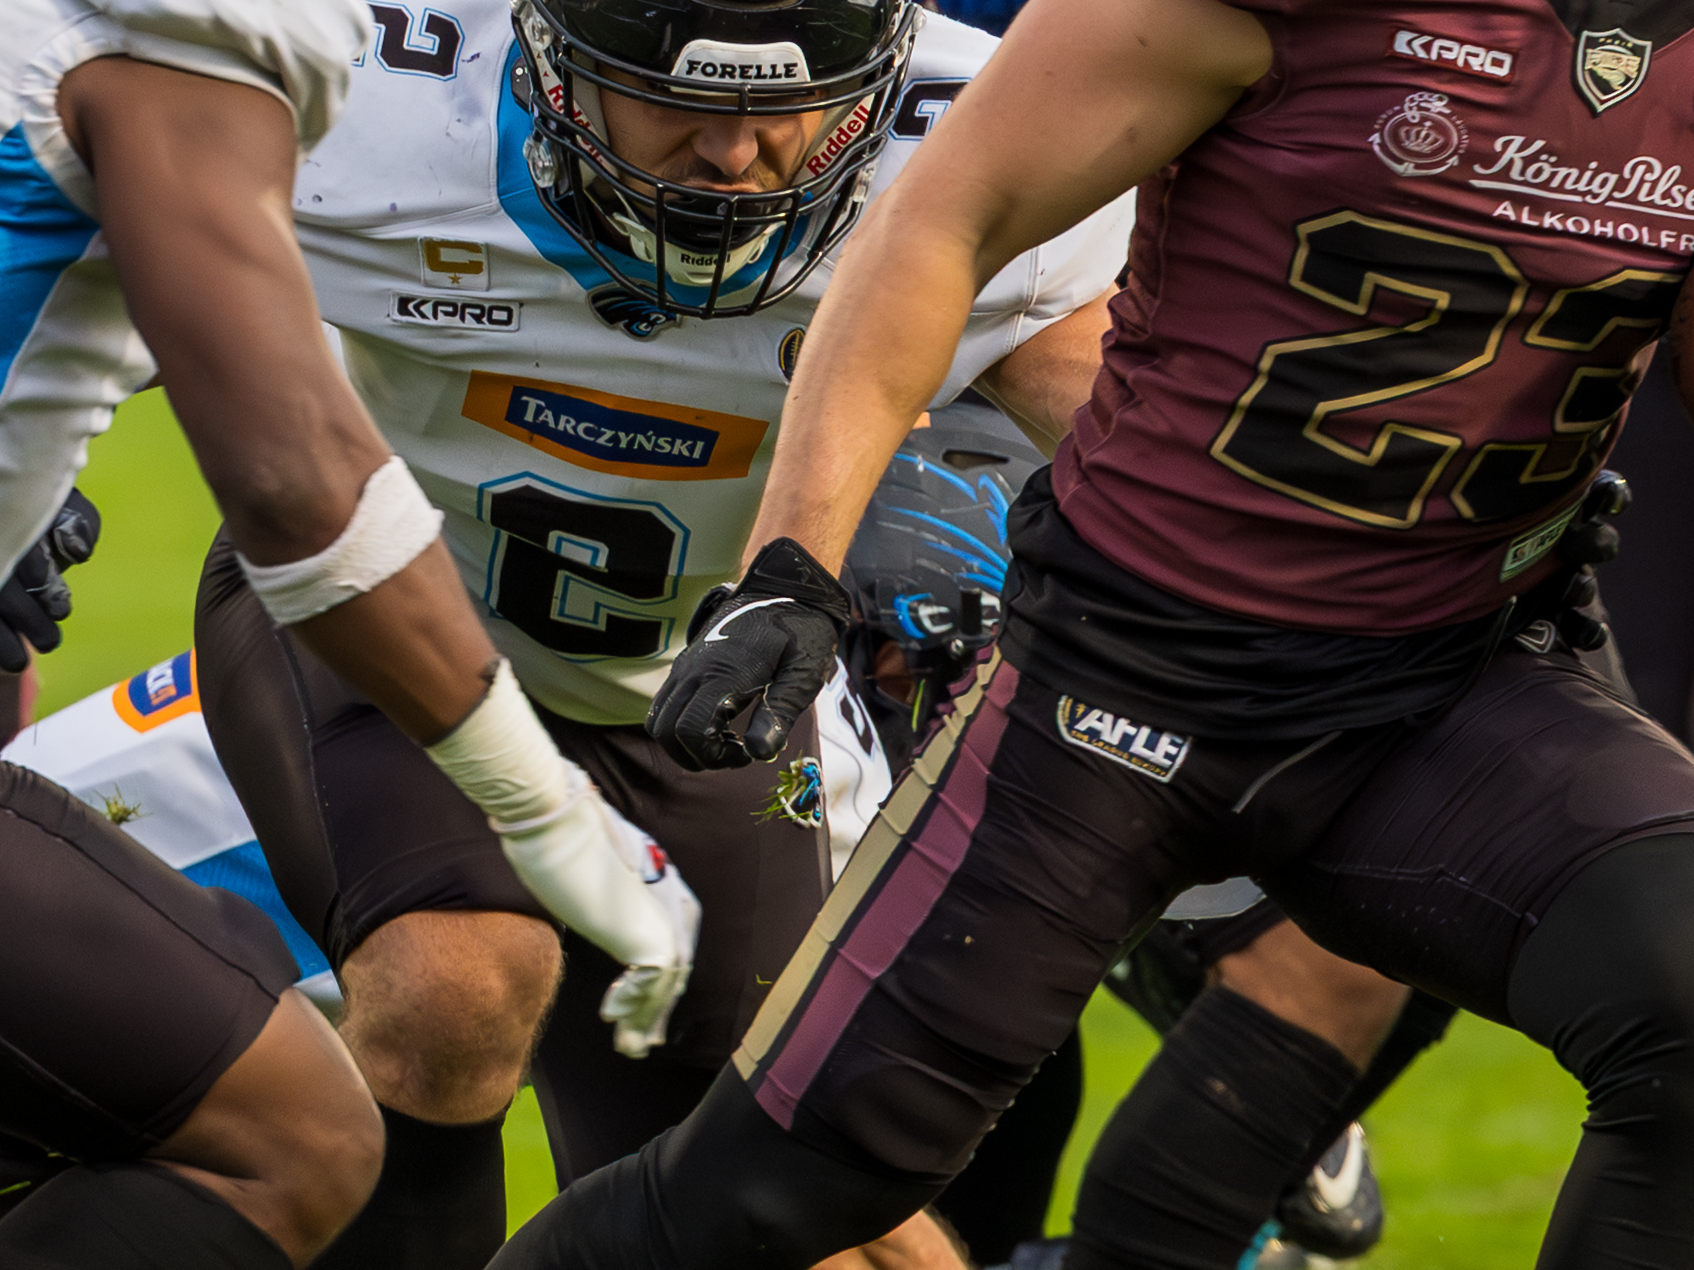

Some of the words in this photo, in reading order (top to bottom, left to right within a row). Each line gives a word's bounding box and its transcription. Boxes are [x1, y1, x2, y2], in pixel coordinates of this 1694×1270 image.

[685, 59, 799, 81] FORELLE
[806, 104, 870, 176] Riddell
[1473, 135, 1619, 204] König
[680, 253, 731, 267] Riddl
[1210, 210, 1685, 528] 23
[520, 395, 705, 460] TARCZYŃSKI
[1073, 708, 1184, 768] AFLE
